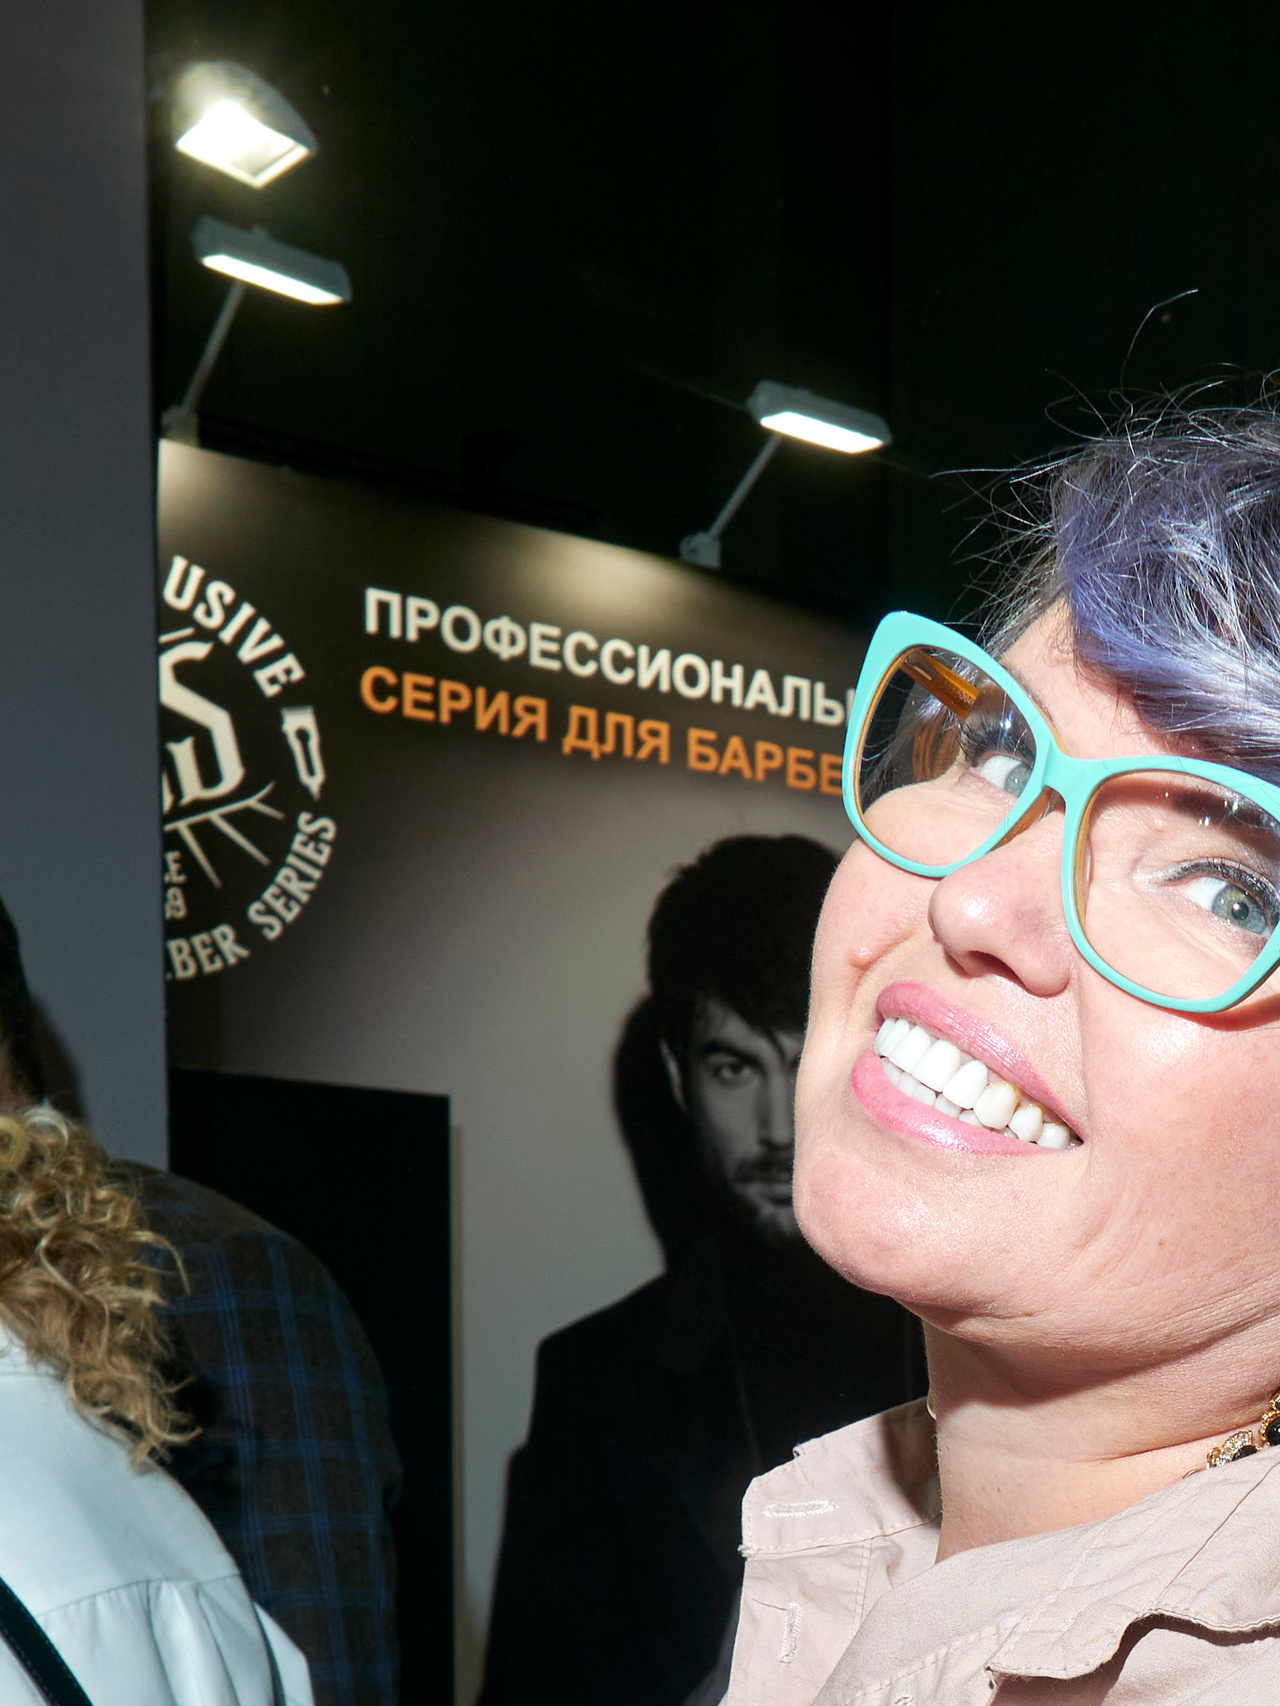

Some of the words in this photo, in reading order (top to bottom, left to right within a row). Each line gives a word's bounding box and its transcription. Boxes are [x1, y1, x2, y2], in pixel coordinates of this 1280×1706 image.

[360, 665, 548, 743] СЕРИЯ
[562, 704, 671, 766] ДЛЯ
[686, 726, 844, 797] БАРБЕ
[166, 923, 250, 982] BER
[247, 810, 338, 942] SERIES
